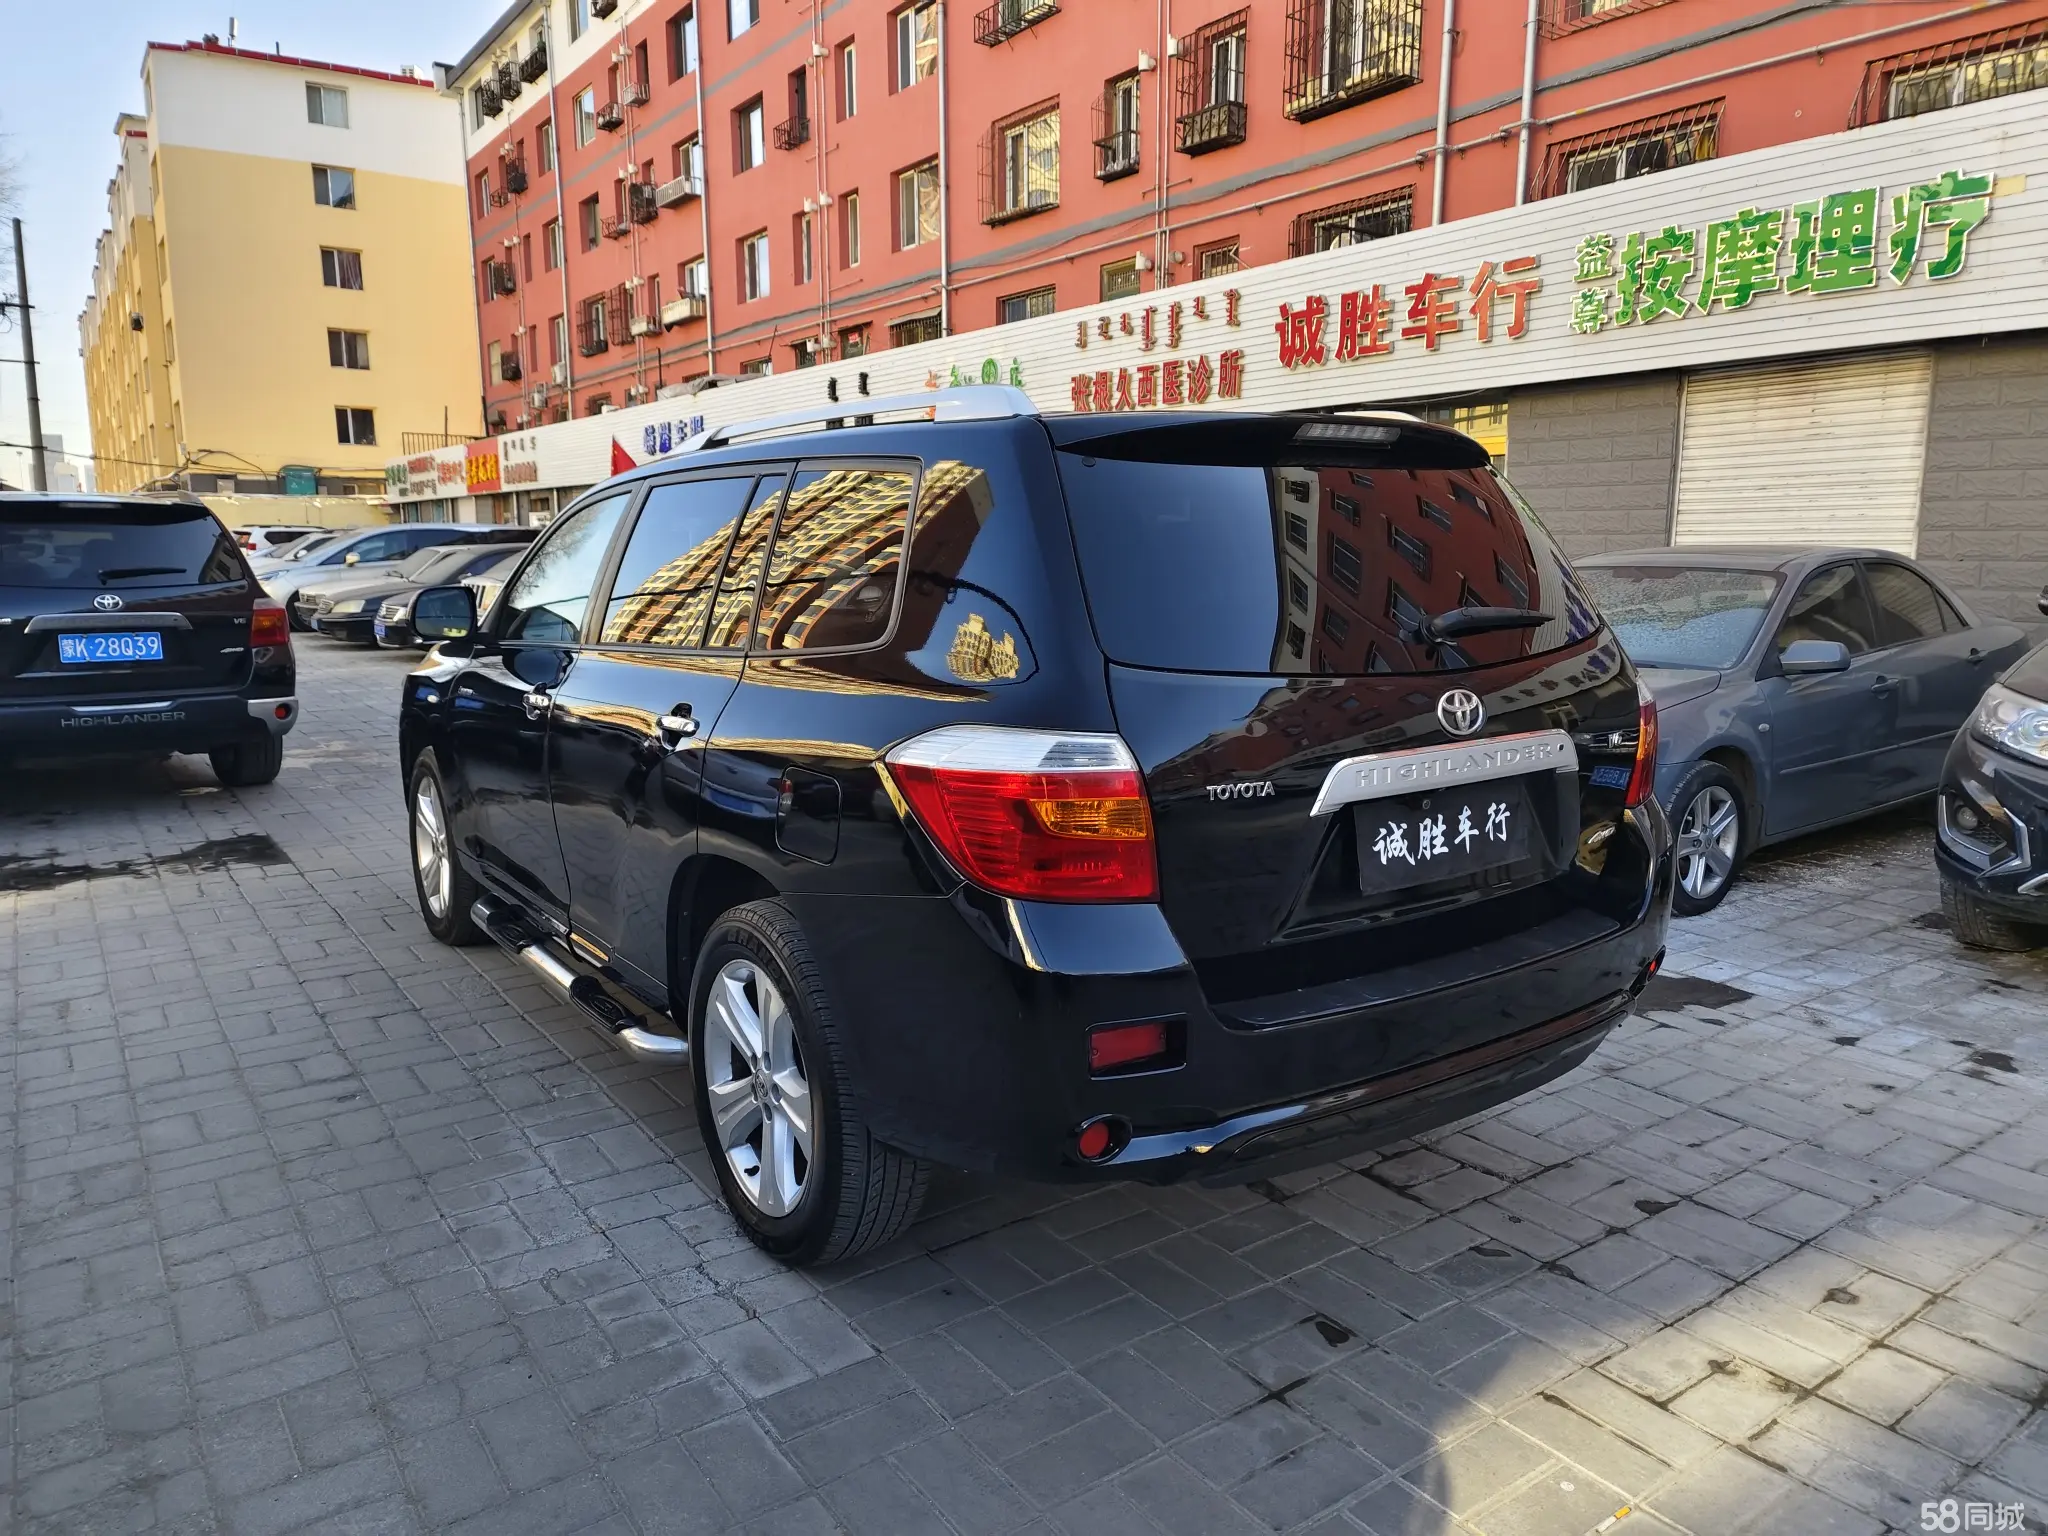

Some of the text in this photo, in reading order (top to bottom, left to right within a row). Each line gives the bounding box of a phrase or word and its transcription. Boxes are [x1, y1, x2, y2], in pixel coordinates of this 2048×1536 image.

[1614, 168, 1995, 326] 按摩理疗
[1274, 254, 1544, 370] 诚胜车行
[1568, 232, 1614, 334] 益尊
[1070, 349, 1245, 412] 张根久西医诊所
[60, 711, 186, 728] HIGHLANDER
[1206, 782, 1276, 801] TOYOTA
[1355, 742, 1552, 788] HIGHLANDER
[1372, 802, 1511, 866] 诚胜车行
